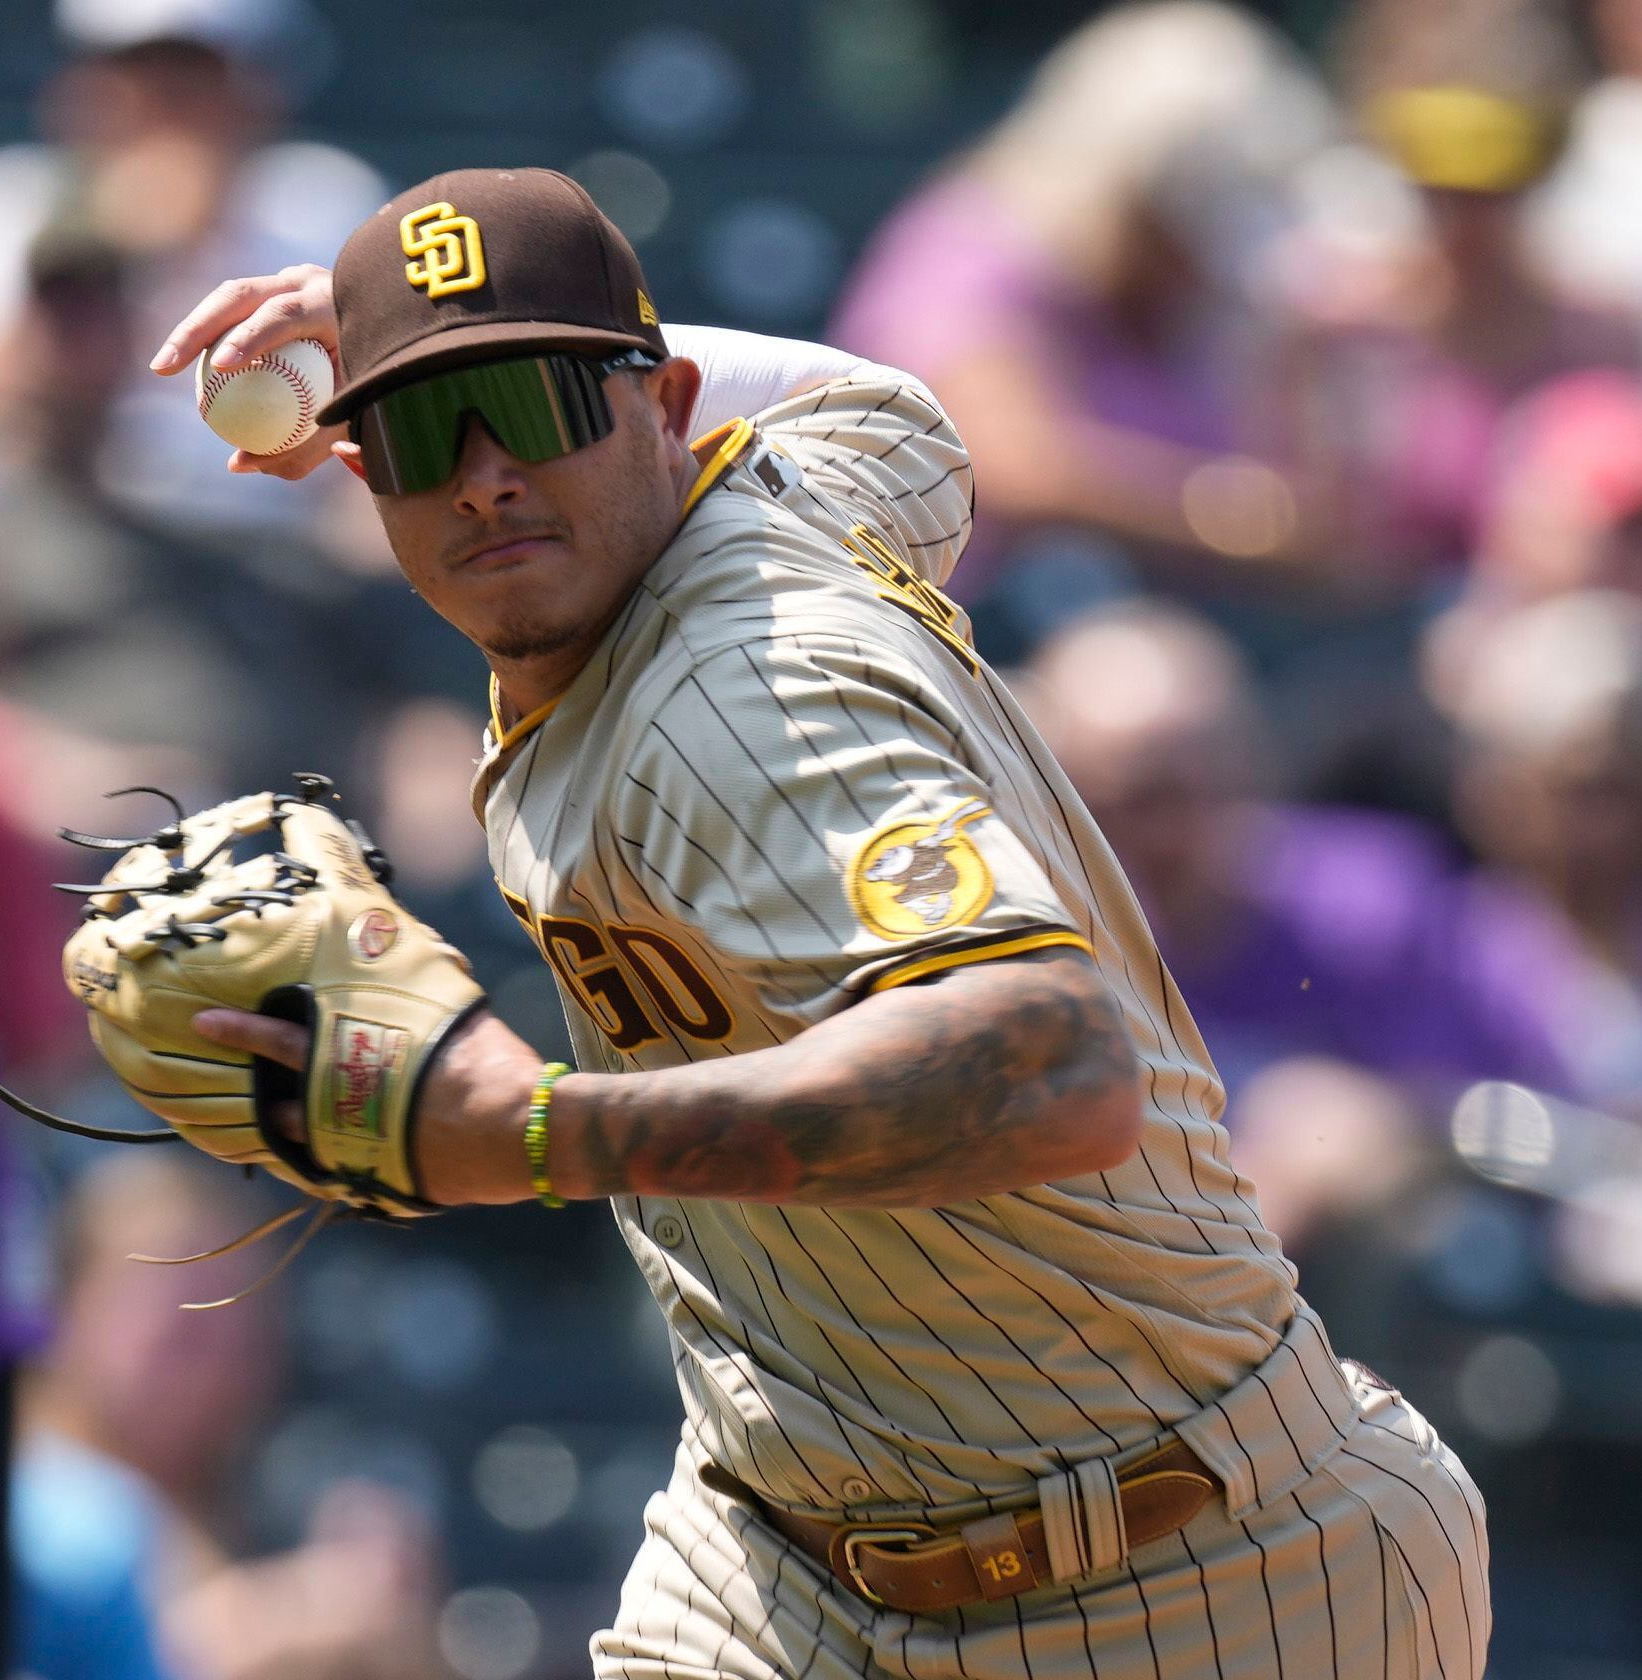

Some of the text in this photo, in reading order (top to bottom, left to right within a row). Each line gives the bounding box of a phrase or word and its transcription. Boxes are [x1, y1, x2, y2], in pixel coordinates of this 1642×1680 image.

[400, 201, 487, 299] SD
[495, 875, 736, 1053] GO
[981, 1551, 1022, 1582] 13
